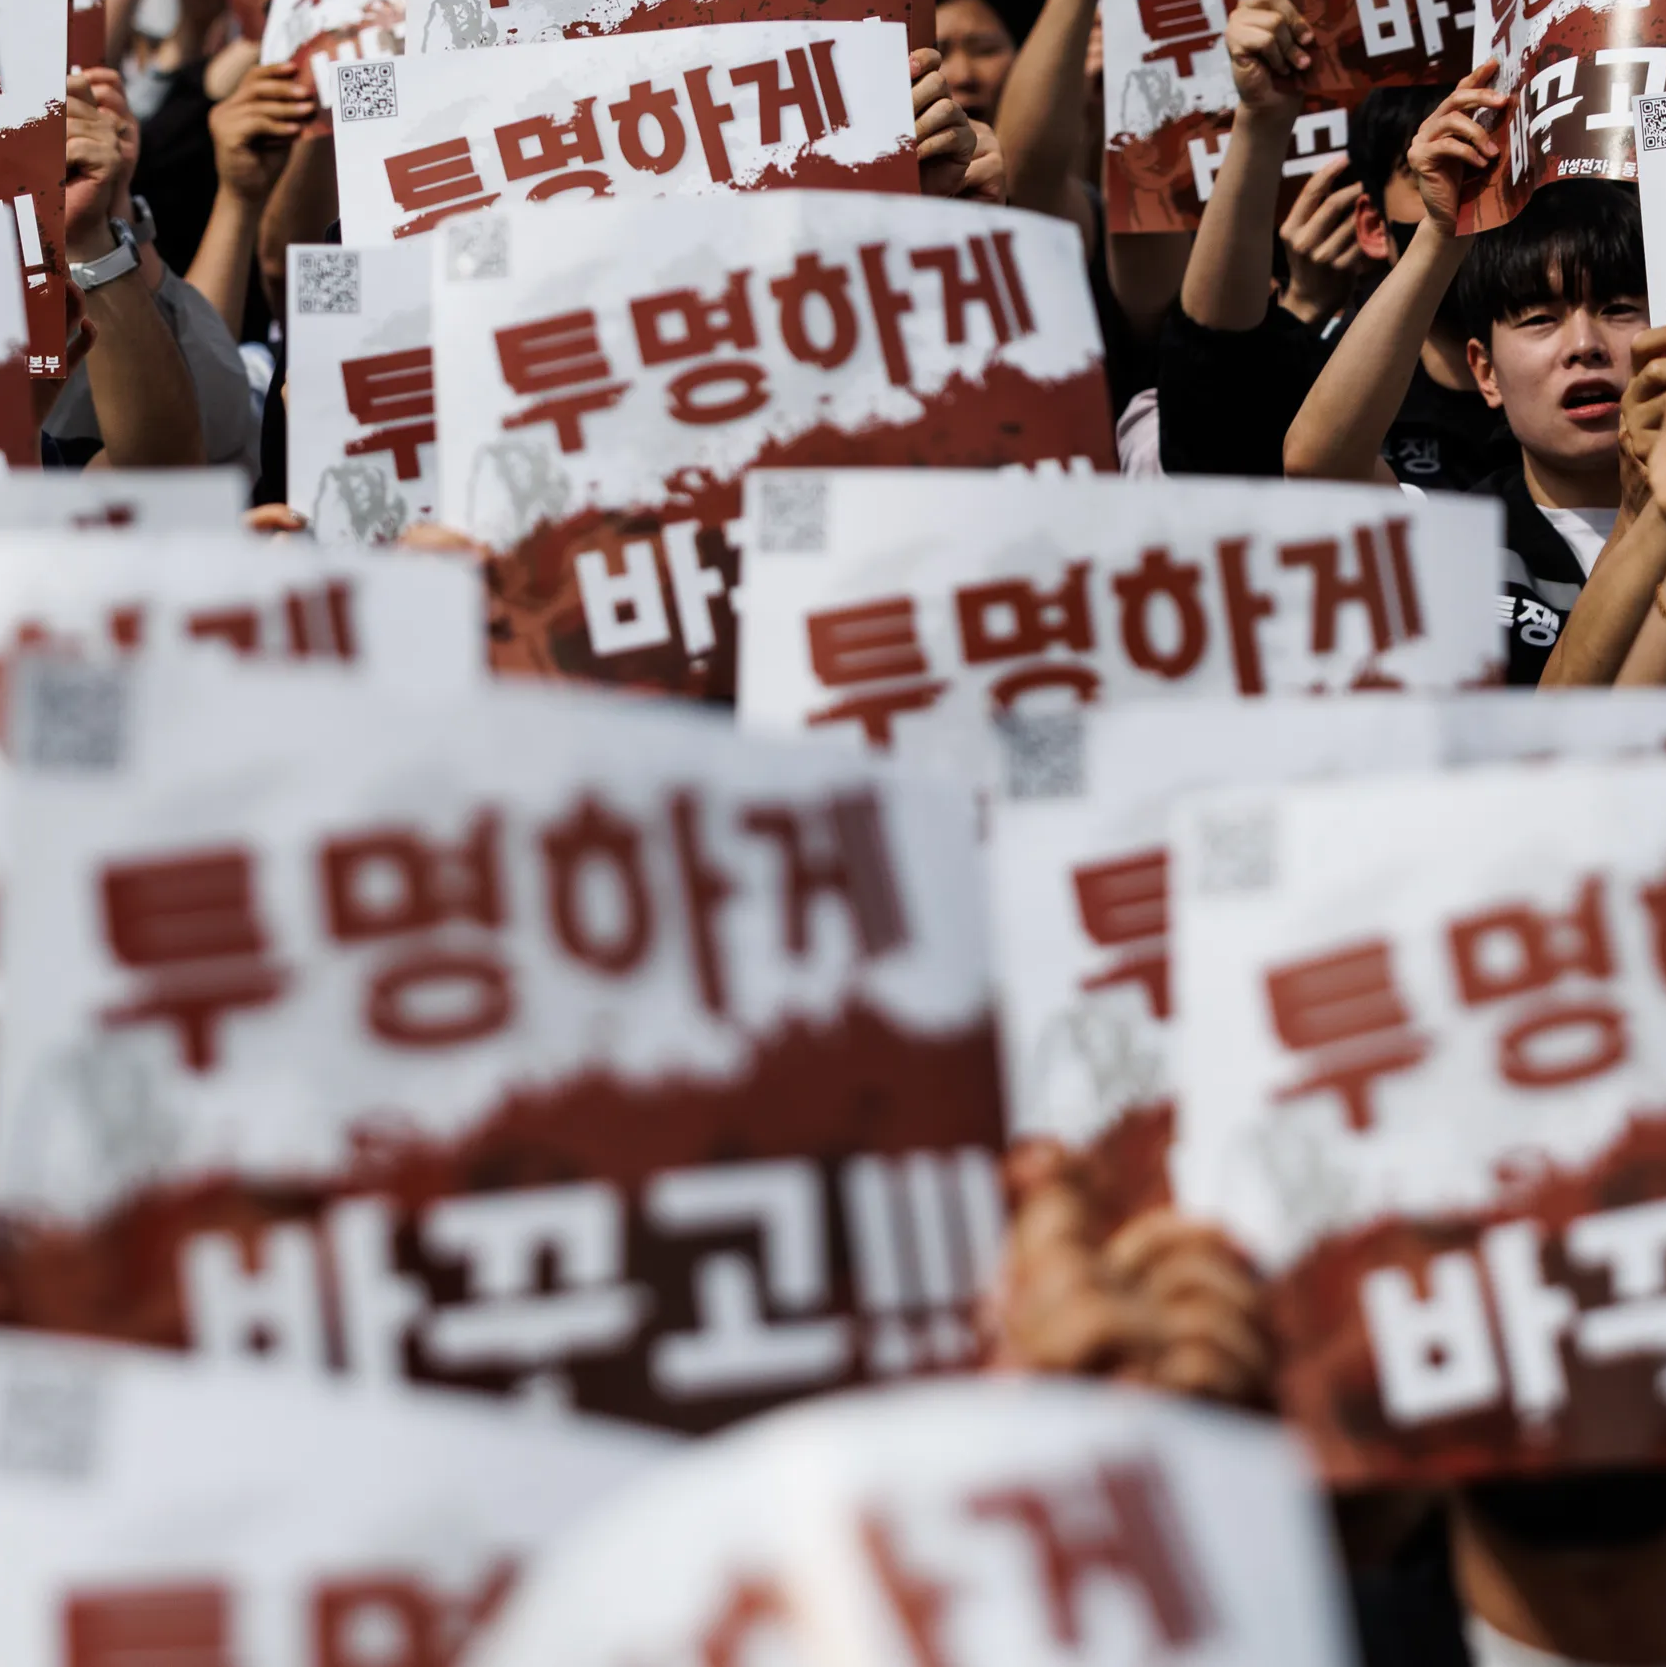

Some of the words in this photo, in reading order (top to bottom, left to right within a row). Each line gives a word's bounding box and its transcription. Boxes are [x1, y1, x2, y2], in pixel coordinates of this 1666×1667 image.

[384, 39, 851, 240] 투명하게
[24, 355, 61, 374] 본부
[494, 230, 1037, 455] 투명하게
[1383, 438, 1441, 474] 쟁
[574, 517, 741, 661] 바
[807, 518, 1424, 754] 투명하게
[101, 783, 915, 1075] 투명하게
